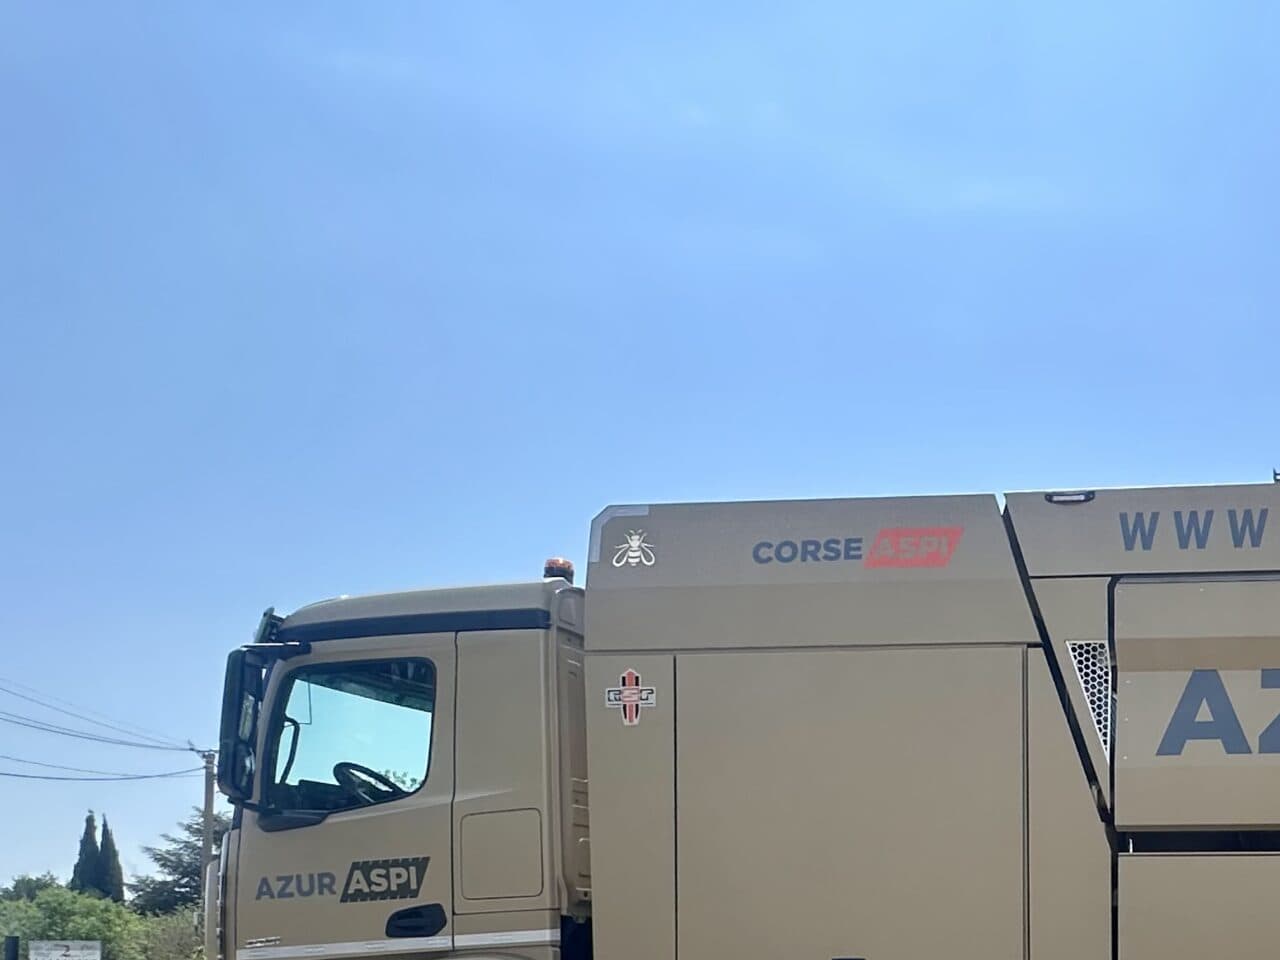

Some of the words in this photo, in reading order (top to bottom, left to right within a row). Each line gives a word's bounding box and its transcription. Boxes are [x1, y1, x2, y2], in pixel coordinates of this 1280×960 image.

[752, 537, 863, 564] CORSE
[870, 535, 948, 560] ASPI
[256, 872, 336, 900] AZUR
[347, 865, 418, 893] ASPI
